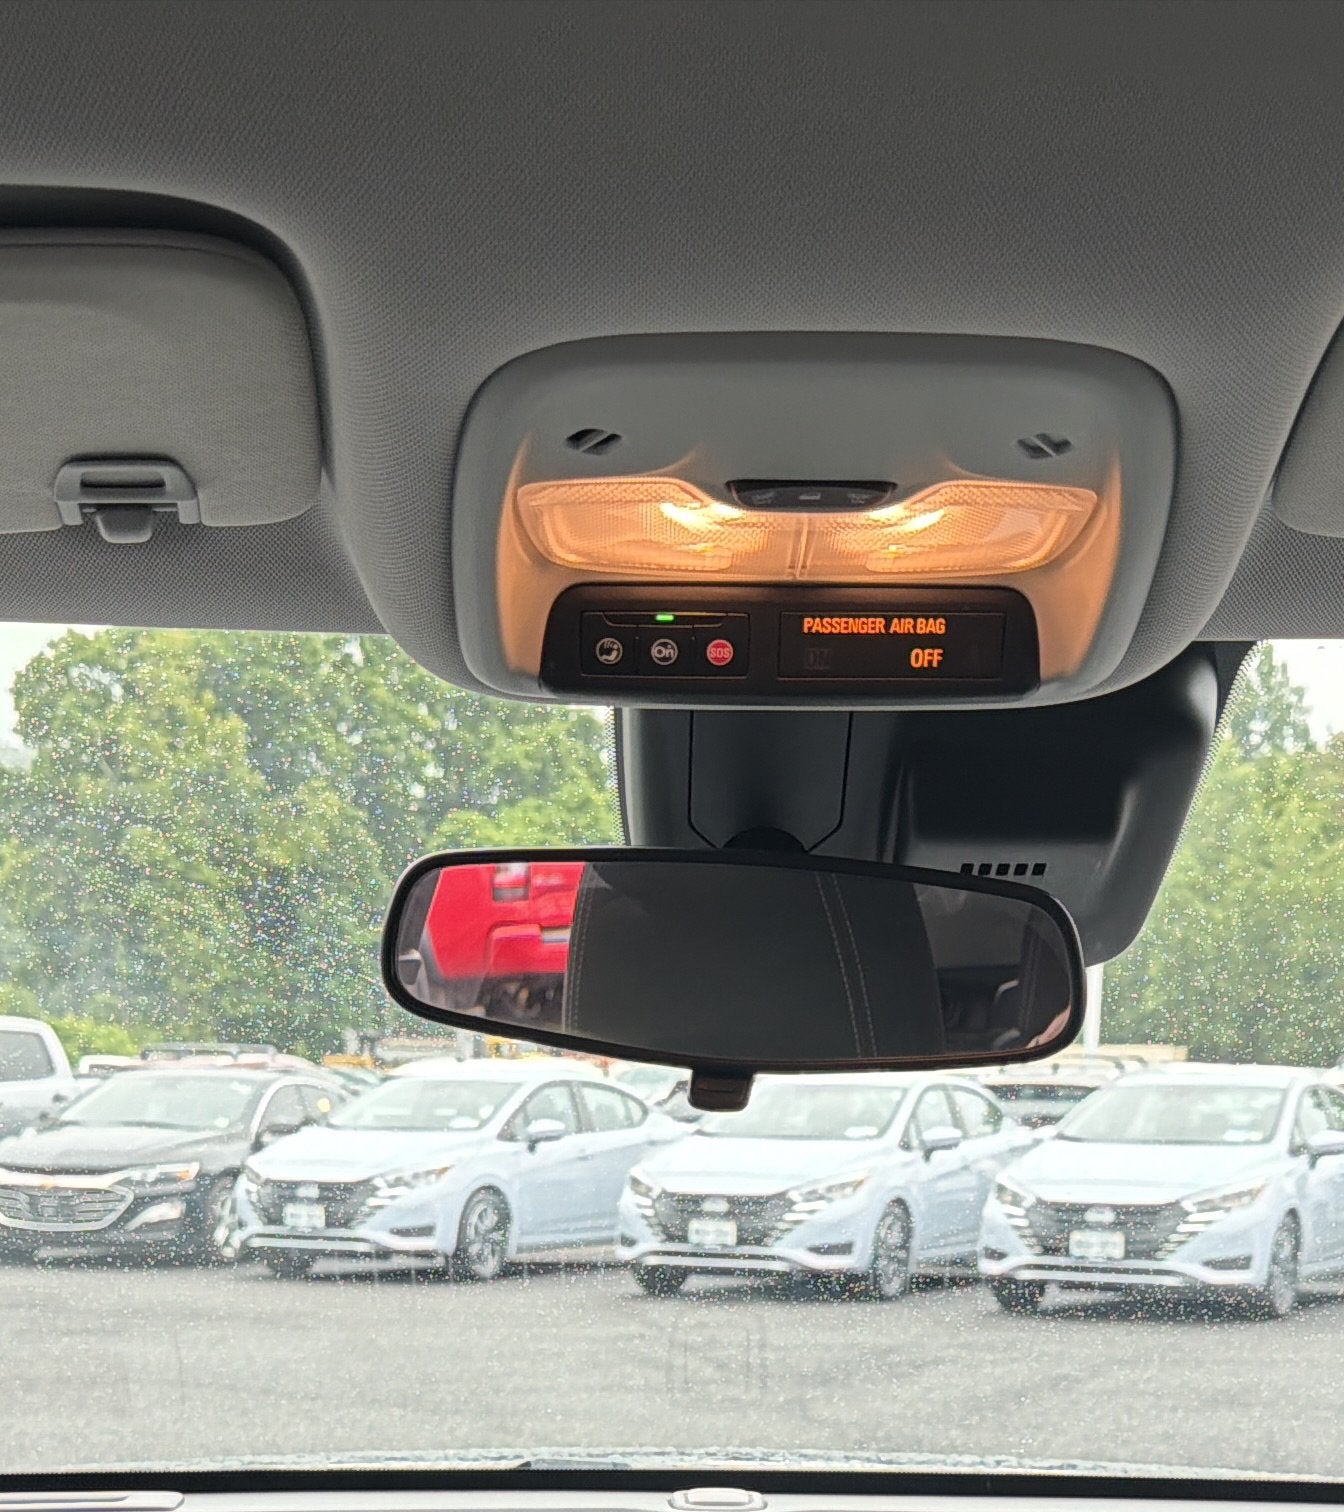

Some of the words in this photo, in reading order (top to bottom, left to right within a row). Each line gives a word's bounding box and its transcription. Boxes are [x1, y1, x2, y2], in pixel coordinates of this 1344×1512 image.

[803, 617, 886, 634] PASSENGER
[888, 617, 914, 634] AIR
[916, 617, 946, 634] BAG
[710, 647, 730, 658] SOS
[910, 648, 944, 668] OFF
